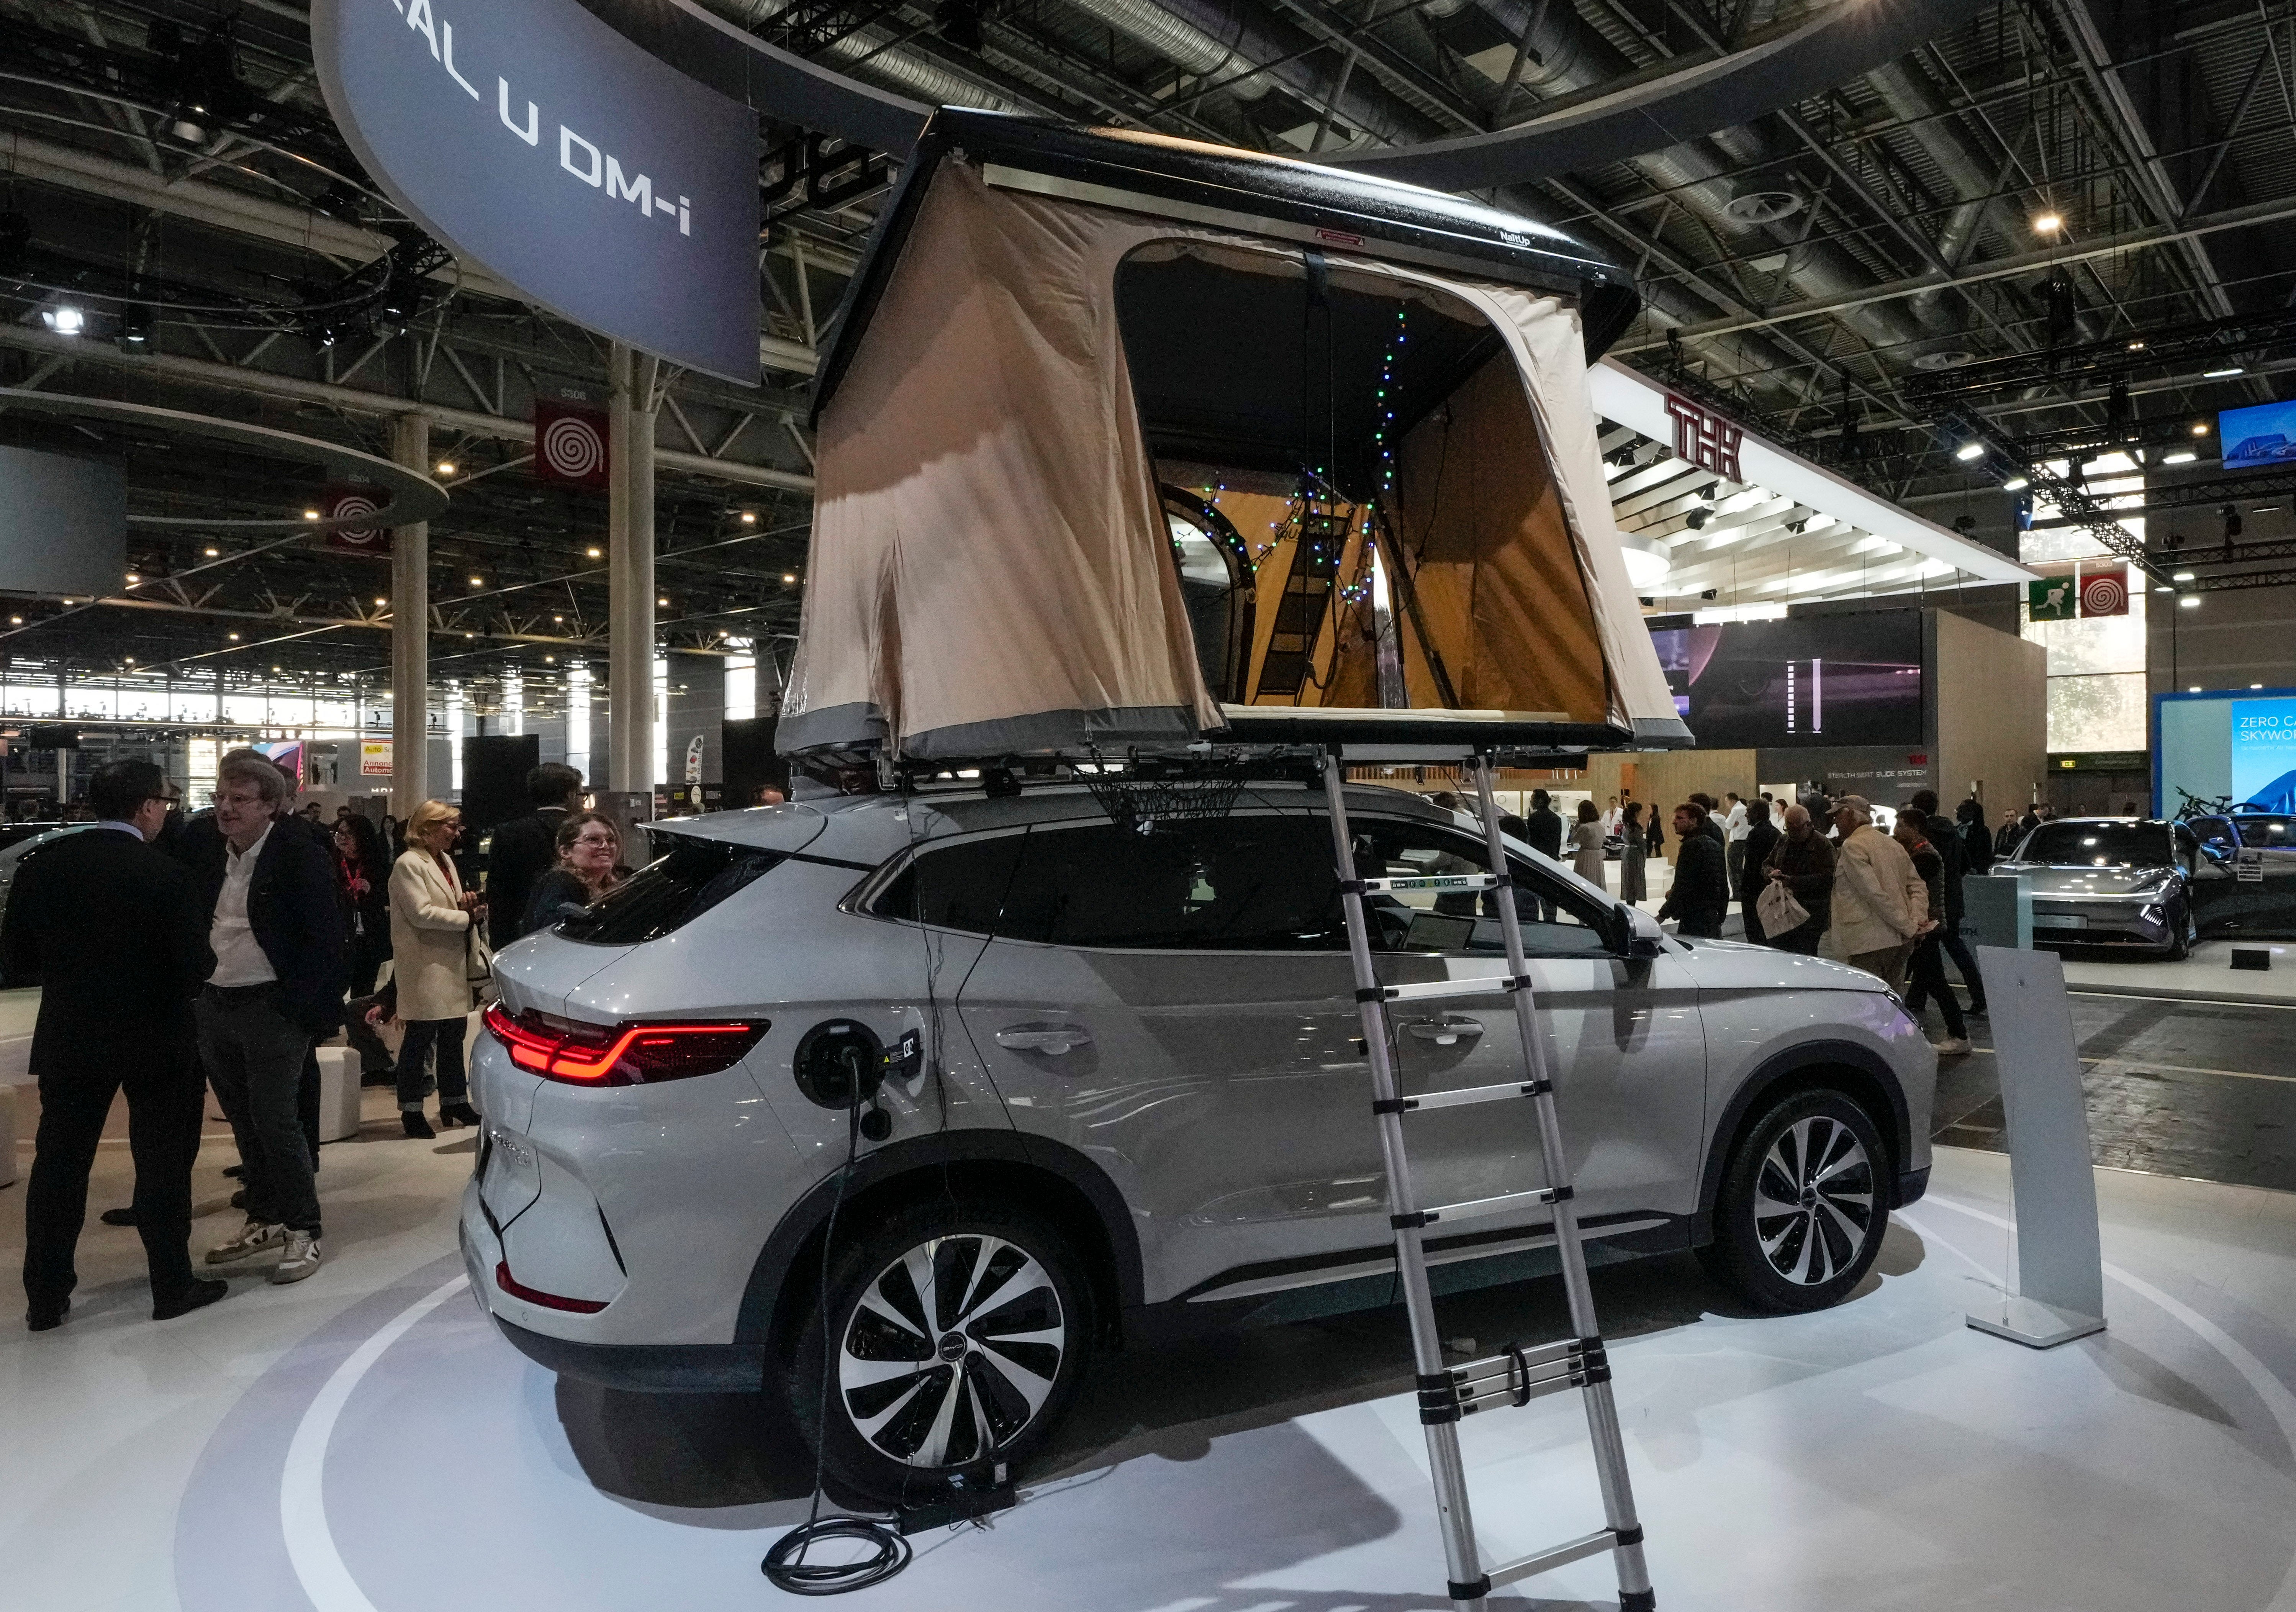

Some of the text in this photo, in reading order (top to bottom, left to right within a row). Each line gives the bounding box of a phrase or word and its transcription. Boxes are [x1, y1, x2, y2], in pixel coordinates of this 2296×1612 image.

[393, 0, 478, 101] AL
[499, 77, 538, 146] U
[560, 124, 690, 236] DM-i
[1664, 392, 1743, 485] THK
[2240, 716, 2278, 727] ZERO
